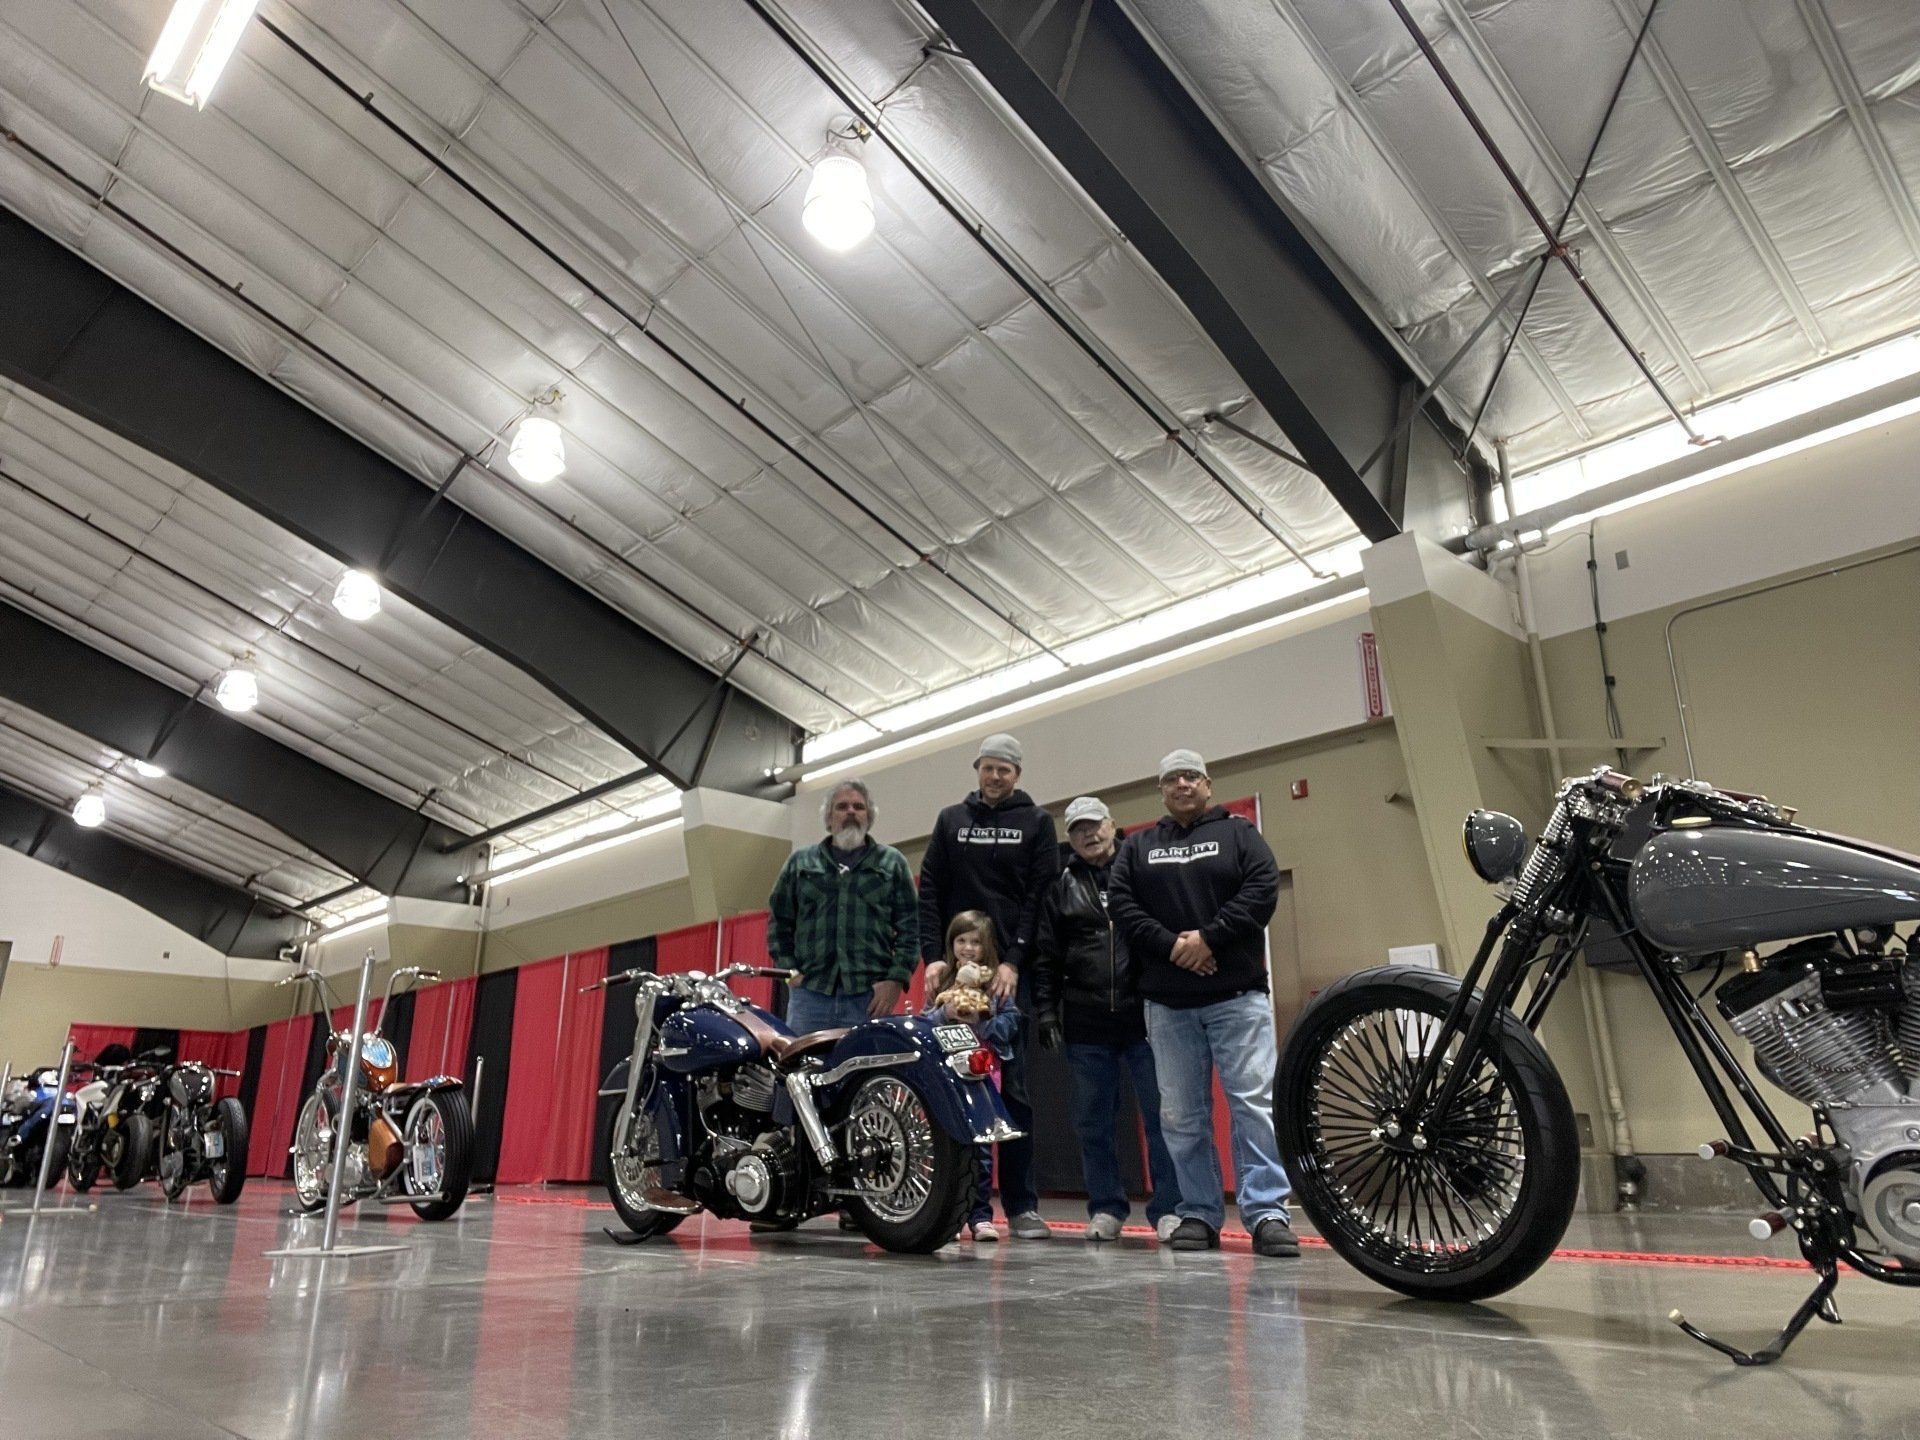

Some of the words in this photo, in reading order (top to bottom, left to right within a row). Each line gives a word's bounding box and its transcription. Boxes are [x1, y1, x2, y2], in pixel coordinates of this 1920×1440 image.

[961, 829, 988, 838] RAIN
[991, 830, 1019, 839] CITY
[1151, 848, 1182, 859] RAIN
[944, 1027, 973, 1042] 7416
